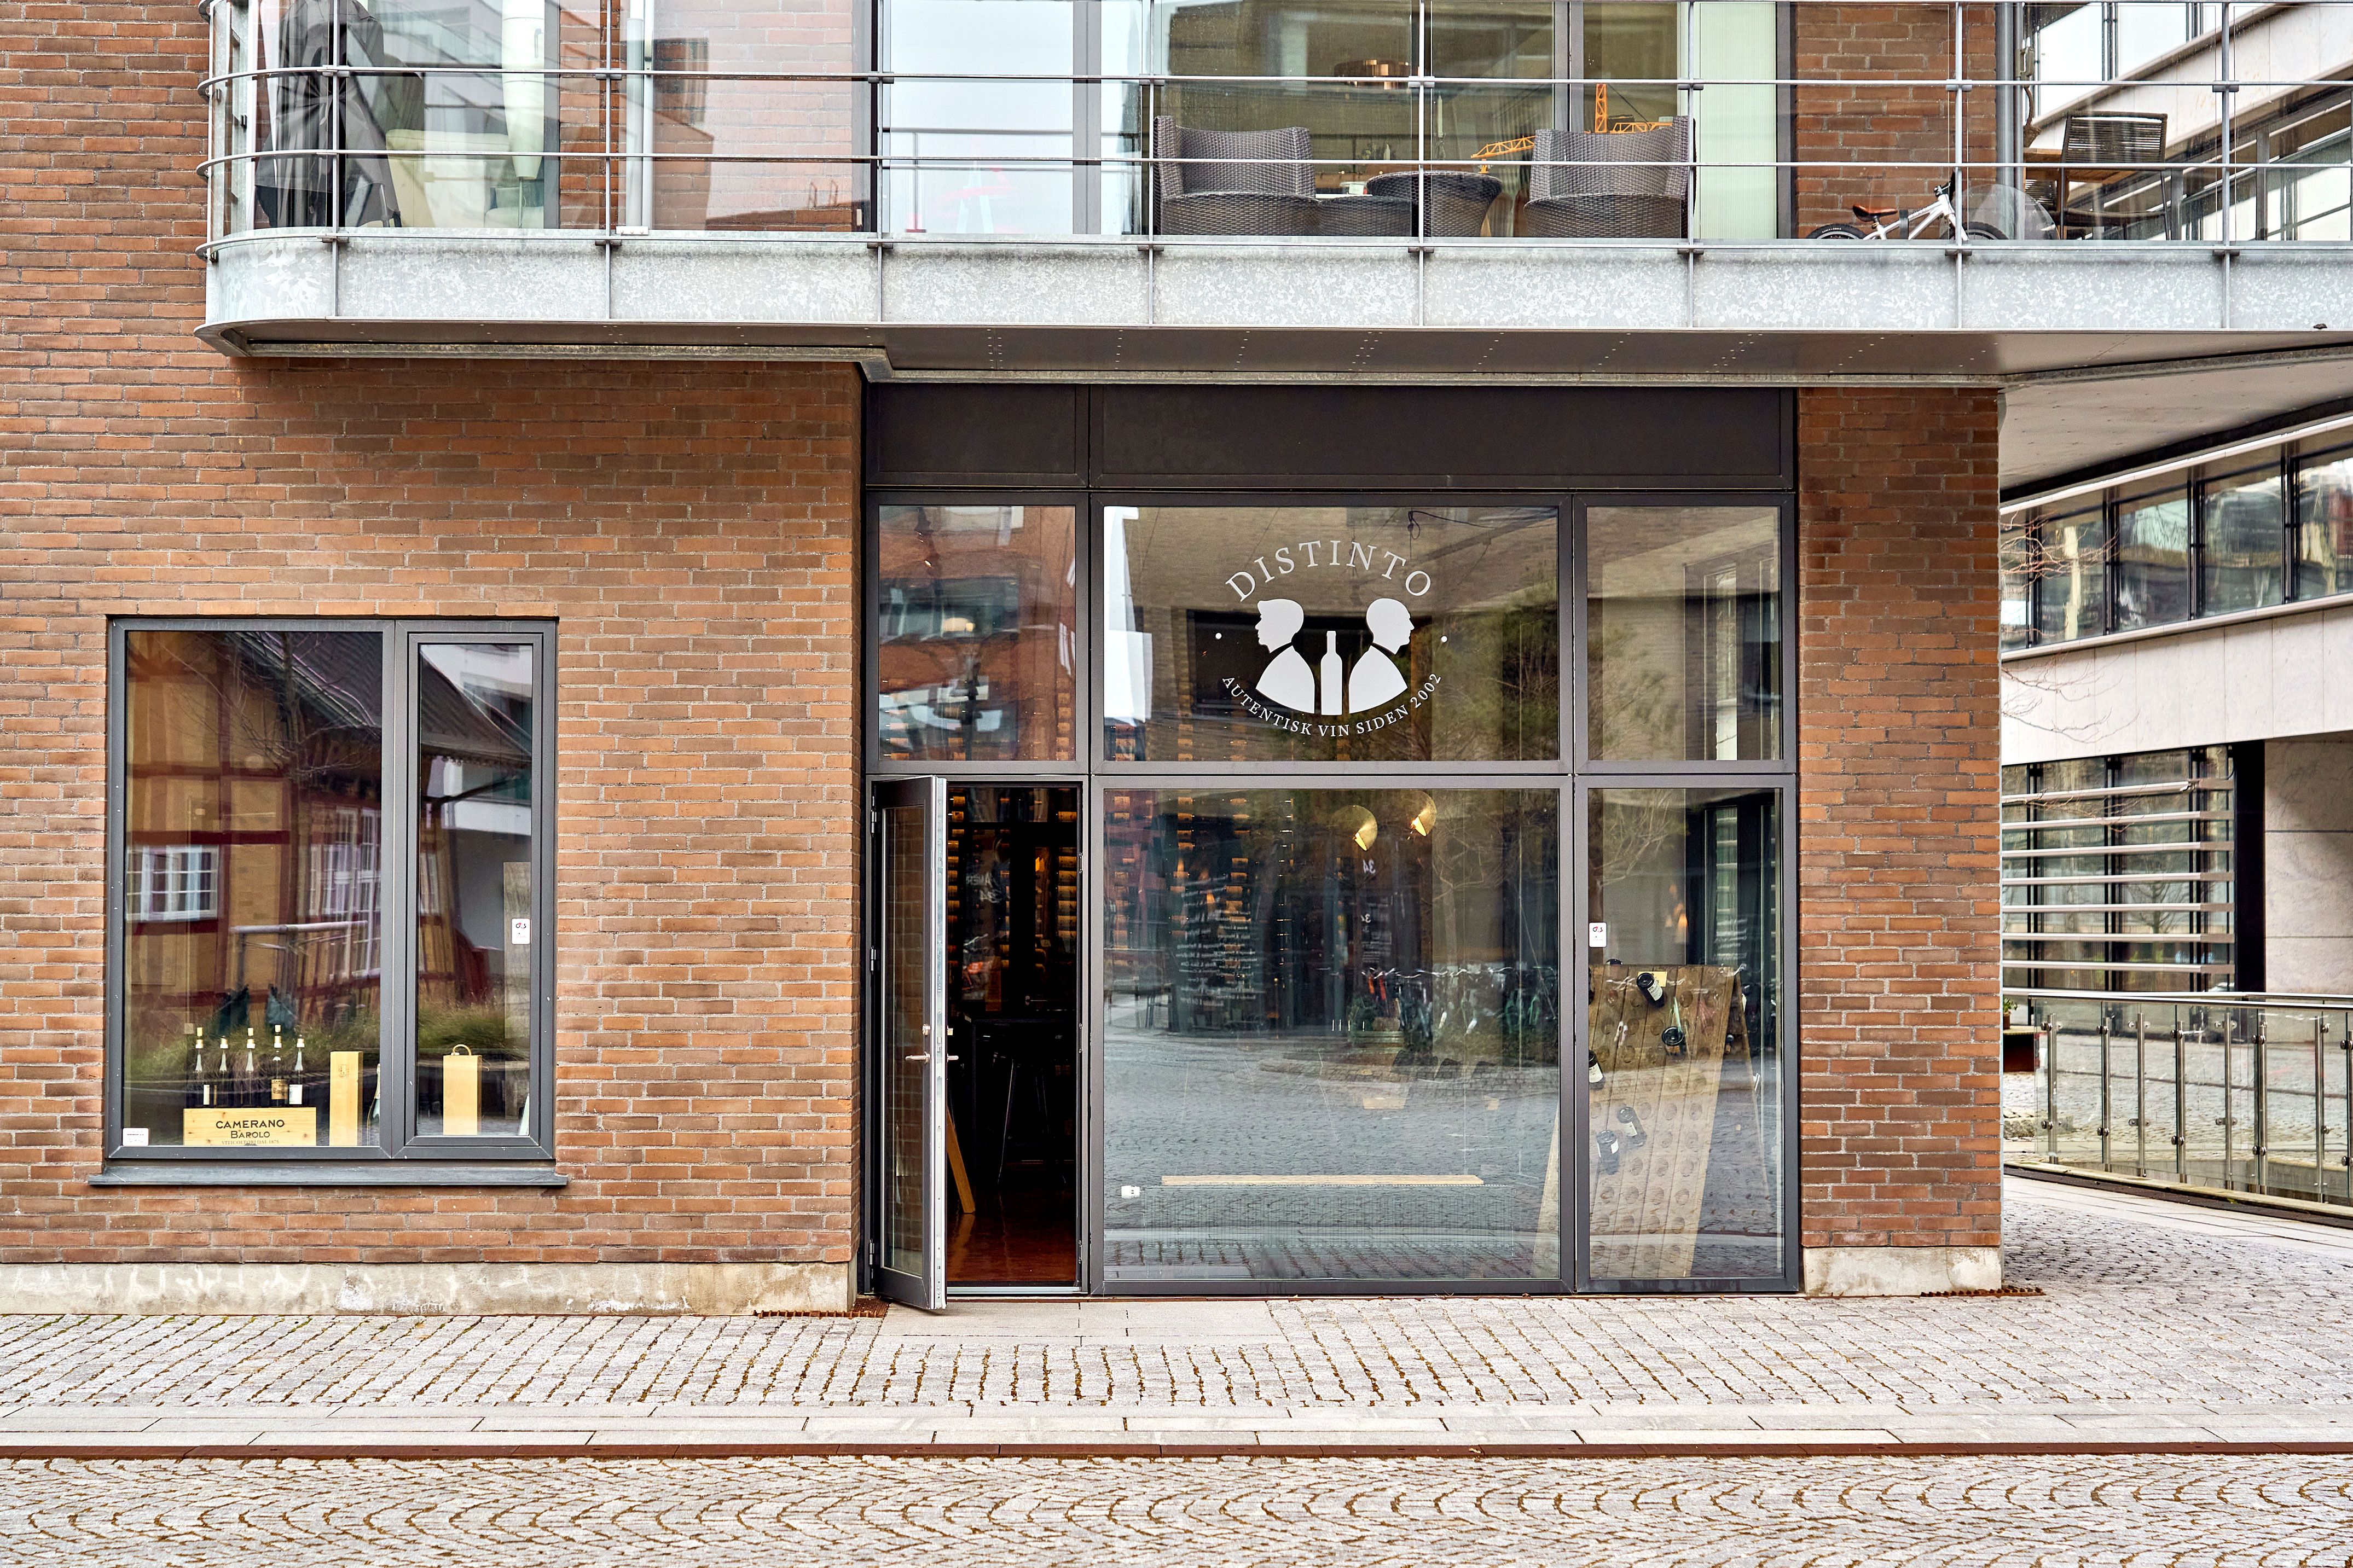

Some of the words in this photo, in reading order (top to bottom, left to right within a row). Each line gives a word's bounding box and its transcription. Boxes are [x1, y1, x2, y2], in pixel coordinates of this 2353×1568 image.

[1225, 540, 1431, 602] DISTINTO
[1222, 676, 1312, 735] AUTENTISK
[1318, 724, 1350, 737] VIN
[1357, 704, 1409, 734] SIDEN
[1410, 673, 1442, 708] 2002
[216, 1119, 285, 1129] CAMERANO
